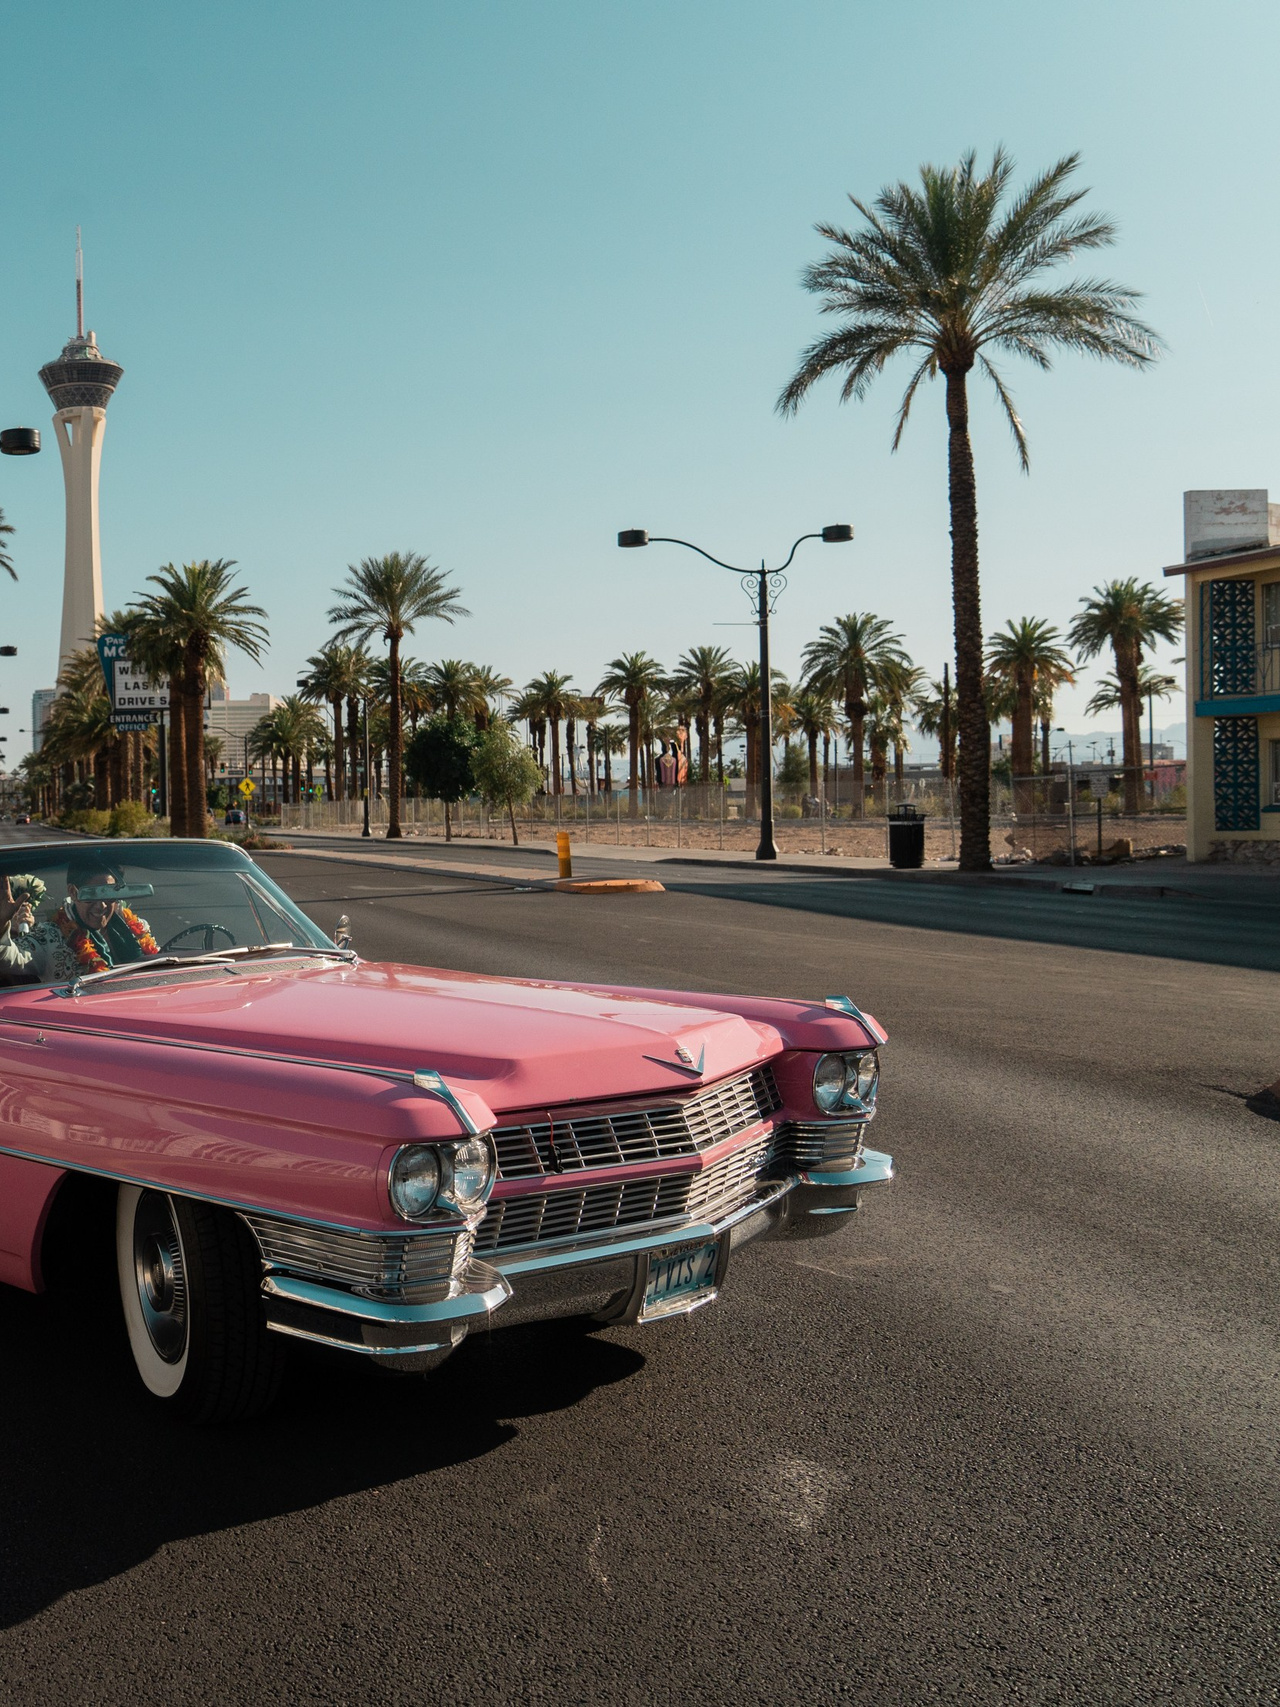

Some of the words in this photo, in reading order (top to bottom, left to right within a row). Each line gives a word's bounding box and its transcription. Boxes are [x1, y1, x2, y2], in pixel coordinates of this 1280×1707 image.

[105, 637, 125, 646] PAR
[104, 646, 128, 657] MO
[118, 666, 146, 675] WEL
[124, 681, 149, 690] LAS
[158, 681, 171, 690] VE
[118, 696, 155, 706] DRIVE
[109, 713, 155, 723] ENTRANCE
[119, 723, 146, 731] OFFICE
[705, 1249, 716, 1278] 2
